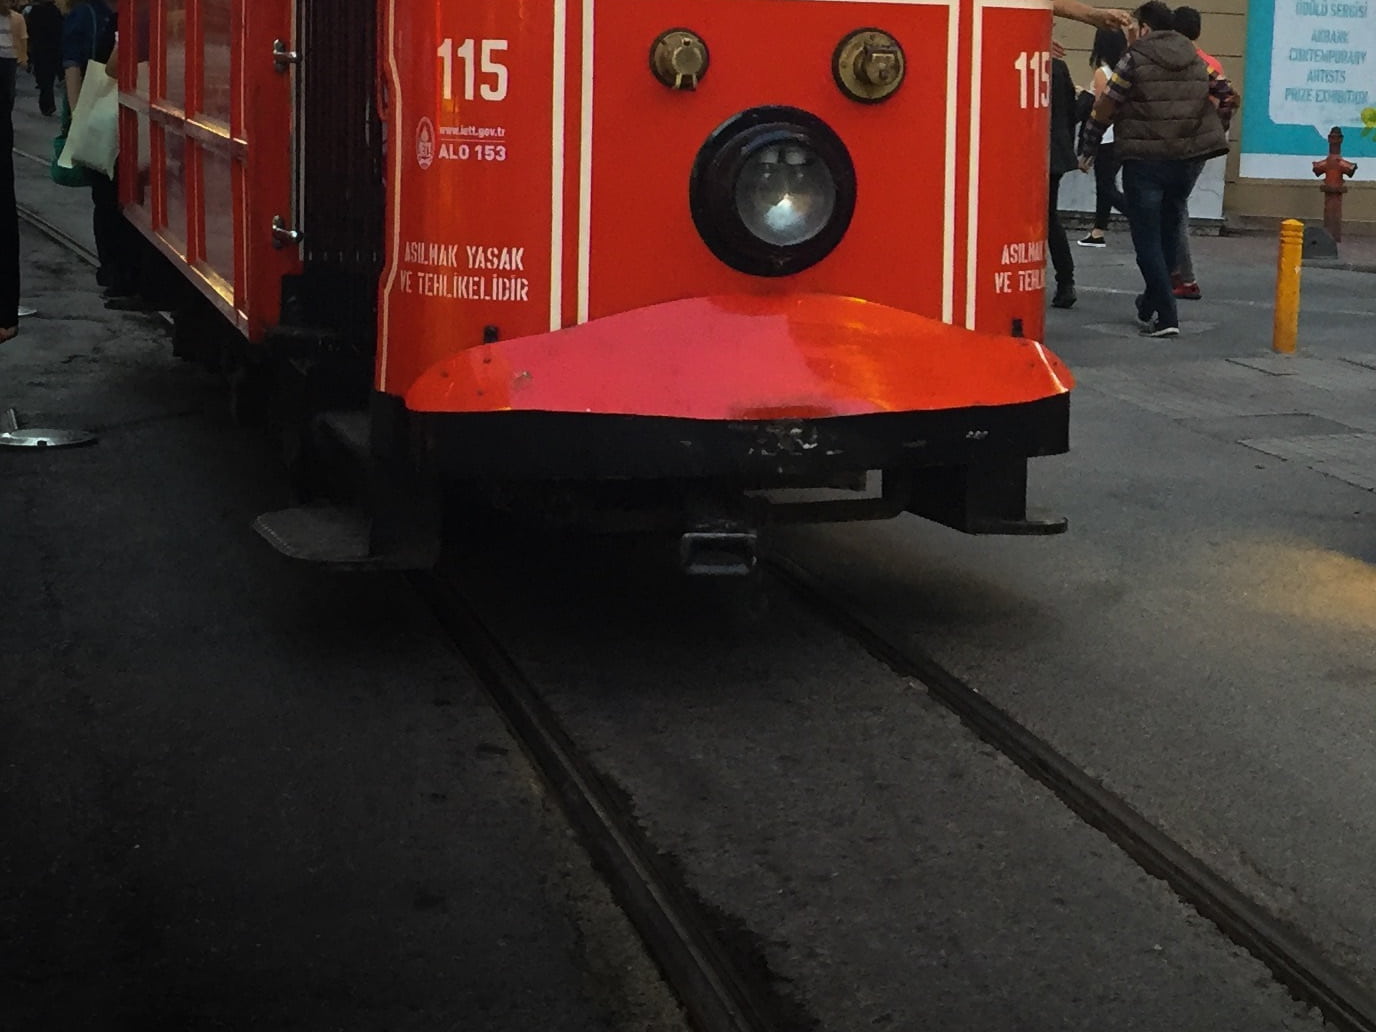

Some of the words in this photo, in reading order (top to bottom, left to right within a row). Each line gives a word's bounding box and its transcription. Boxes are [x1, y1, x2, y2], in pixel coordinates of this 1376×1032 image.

[437, 38, 509, 102] 115
[438, 143, 470, 160] ALO
[474, 145, 507, 161] 153
[405, 241, 459, 268] ASILMAK
[466, 245, 525, 271] YASAK
[400, 270, 413, 294] VE
[418, 272, 529, 302] TEHLİKELİDİR
[994, 271, 1013, 294] VE
